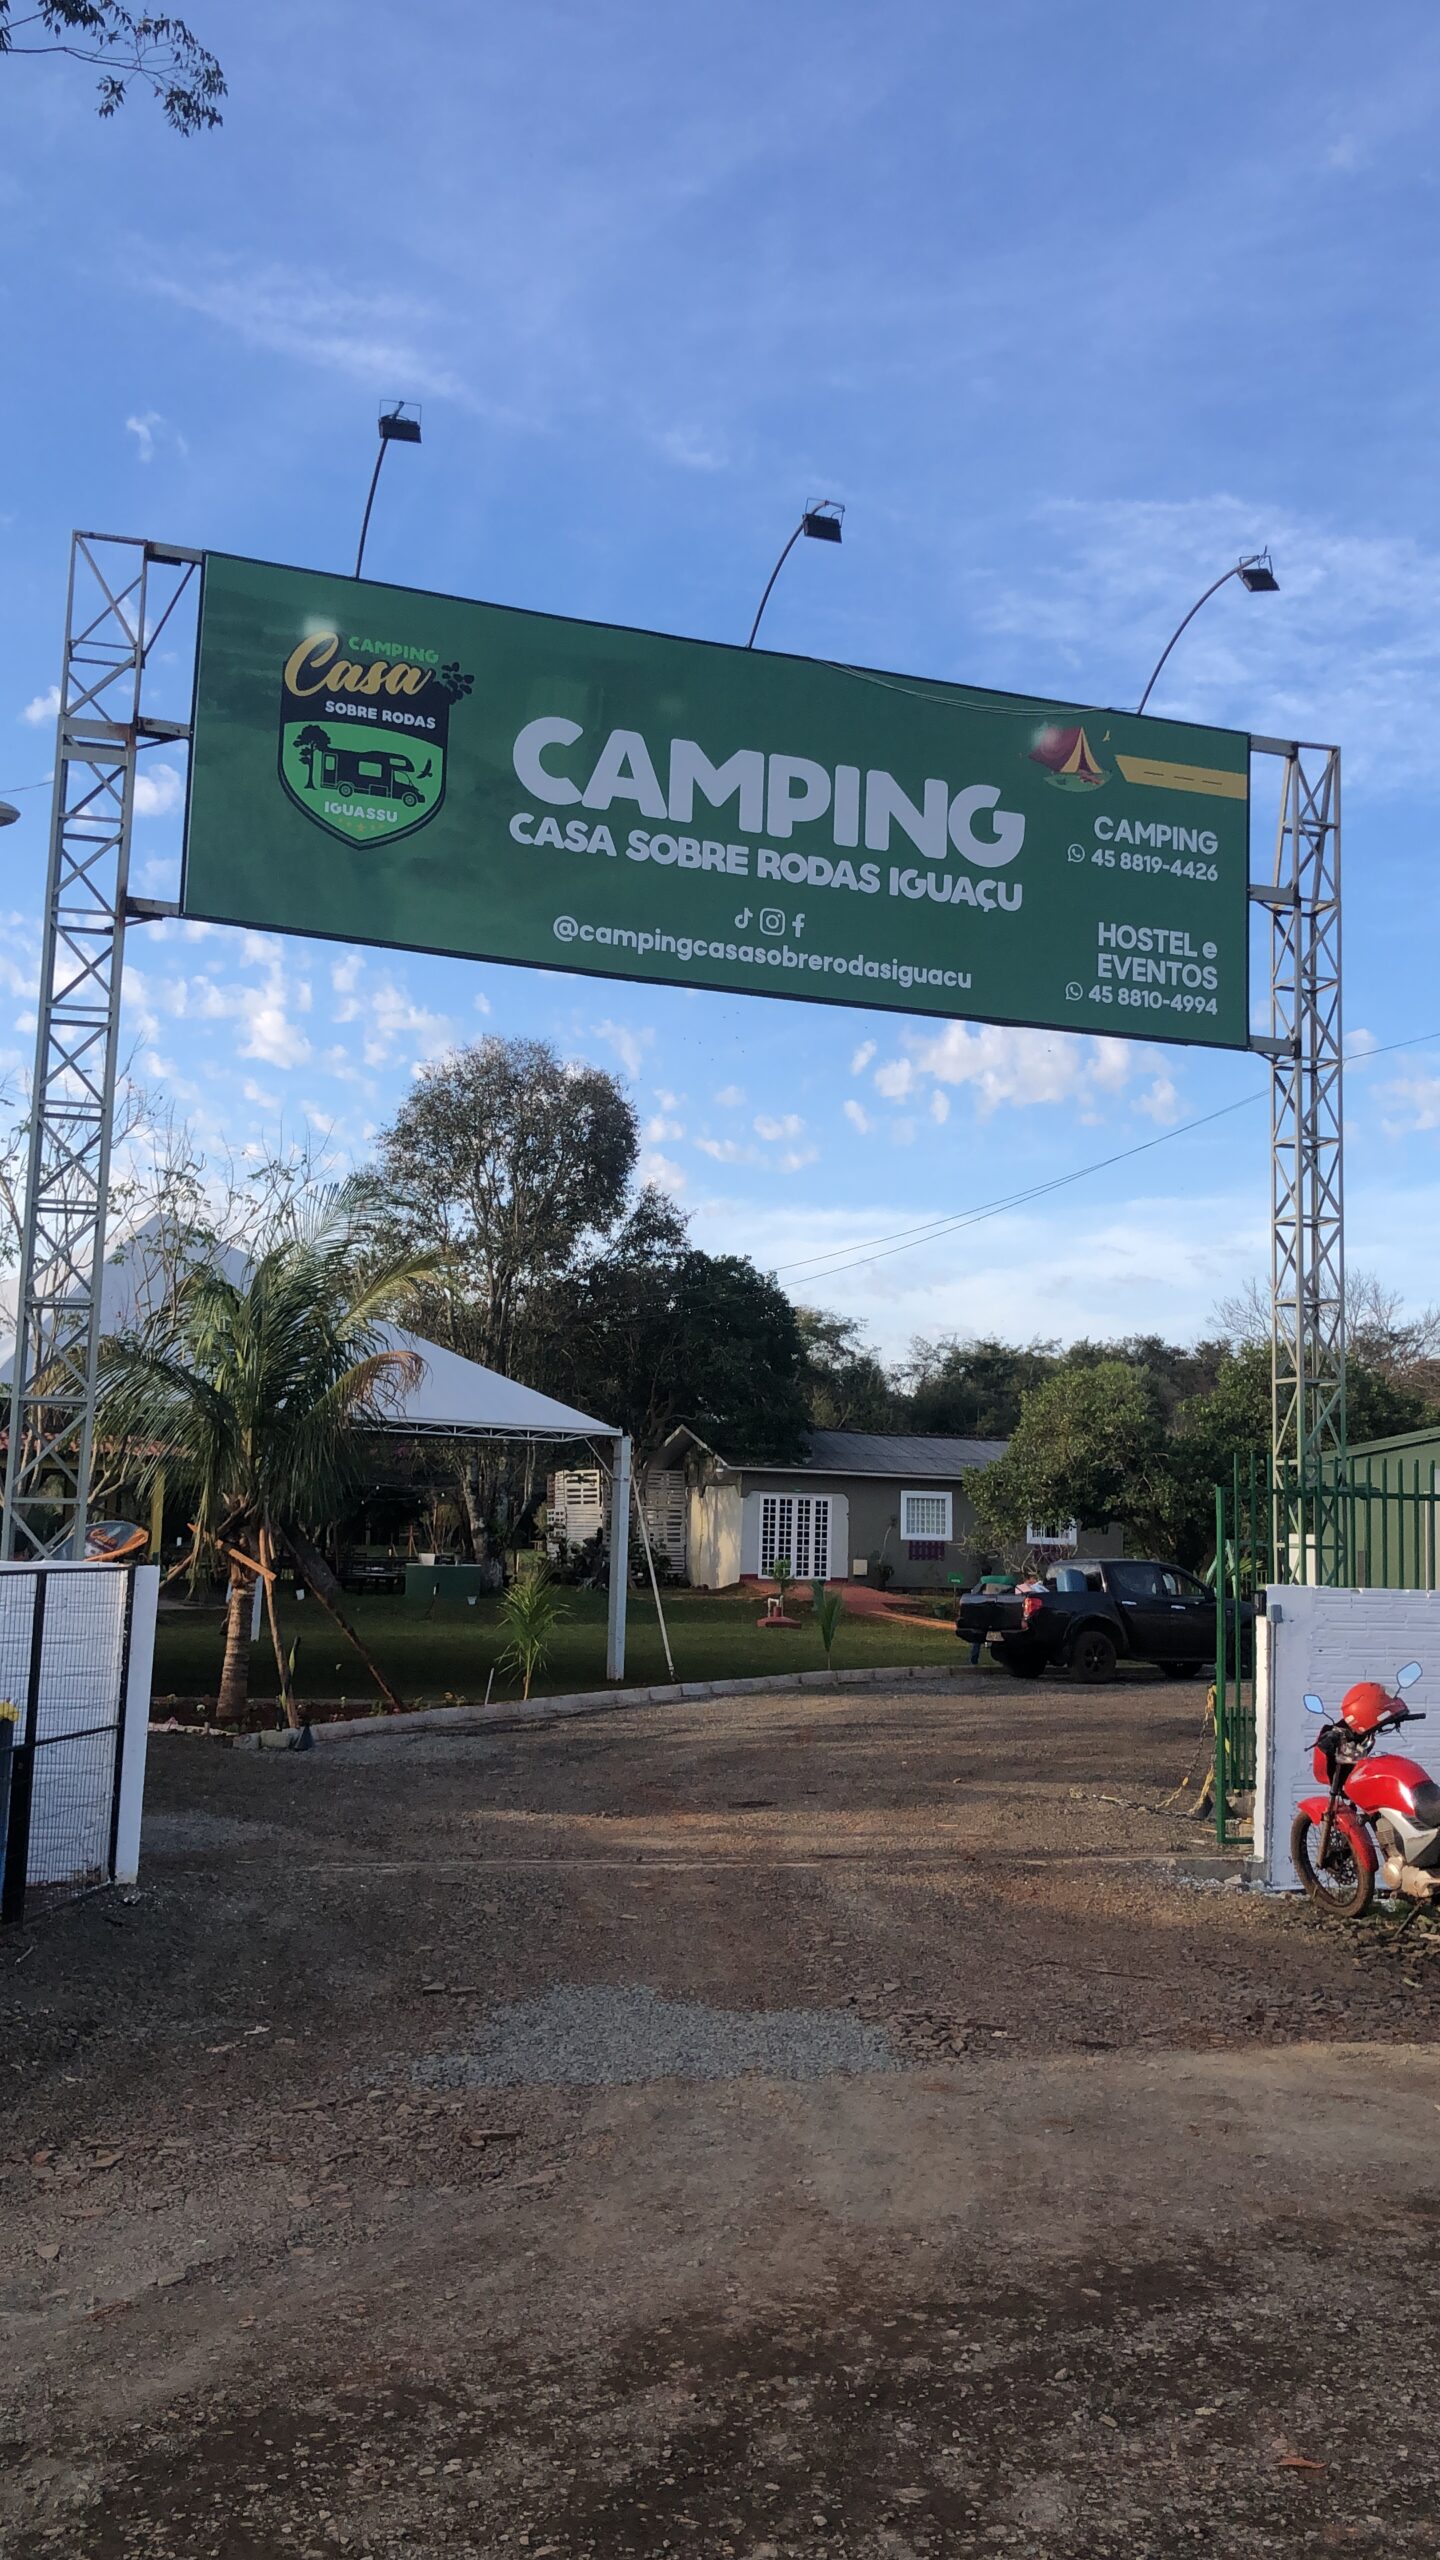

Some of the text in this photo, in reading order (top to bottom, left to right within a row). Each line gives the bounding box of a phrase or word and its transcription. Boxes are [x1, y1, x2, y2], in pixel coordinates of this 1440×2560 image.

[284, 630, 432, 697] Casa
[347, 635, 440, 665] CAMPING
[324, 700, 437, 730] SOBRE RODAS
[512, 716, 1026, 868] CAMPING
[324, 801, 398, 823] IGUASSU
[1093, 815, 1219, 856] CAMPING
[509, 812, 1024, 913] CASA SOBRE RODAS IGUAÇU
[1090, 848, 1219, 882] 45 8819-4426
[553, 914, 973, 990] @campingcasasobrerodasiguacu
[1097, 921, 1198, 958] HOSTEL
[1096, 952, 1219, 990] EVENTOS
[1088, 984, 1218, 1016] 45 8810-4994
